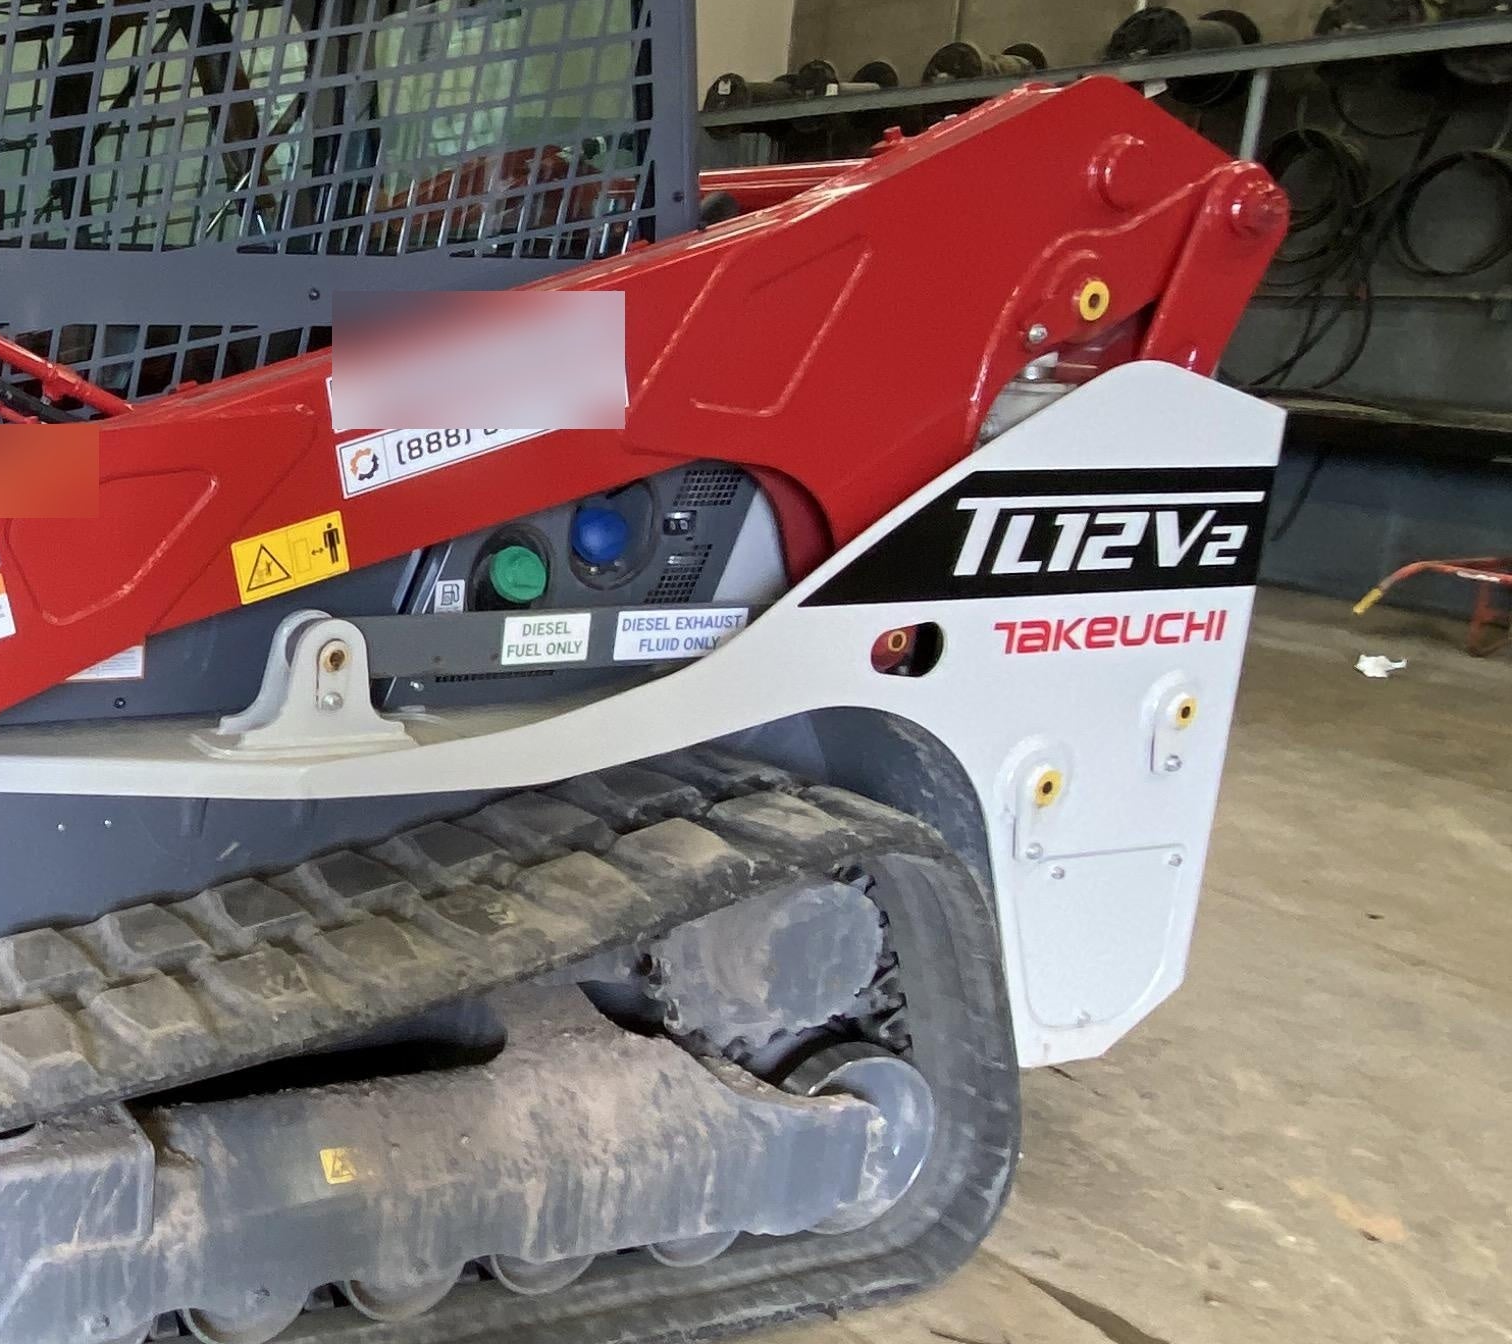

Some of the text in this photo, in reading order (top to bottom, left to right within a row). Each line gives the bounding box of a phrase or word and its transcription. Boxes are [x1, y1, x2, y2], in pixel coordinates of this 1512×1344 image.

[953, 491, 1266, 576] TL12V2
[522, 622, 571, 637] DIESEL
[622, 615, 743, 632] DIESEL EXHAUST
[994, 610, 1227, 654] TAKEUCHI
[507, 641, 583, 658] FUEL ONLY
[638, 635, 720, 653] FLUID ONLY
